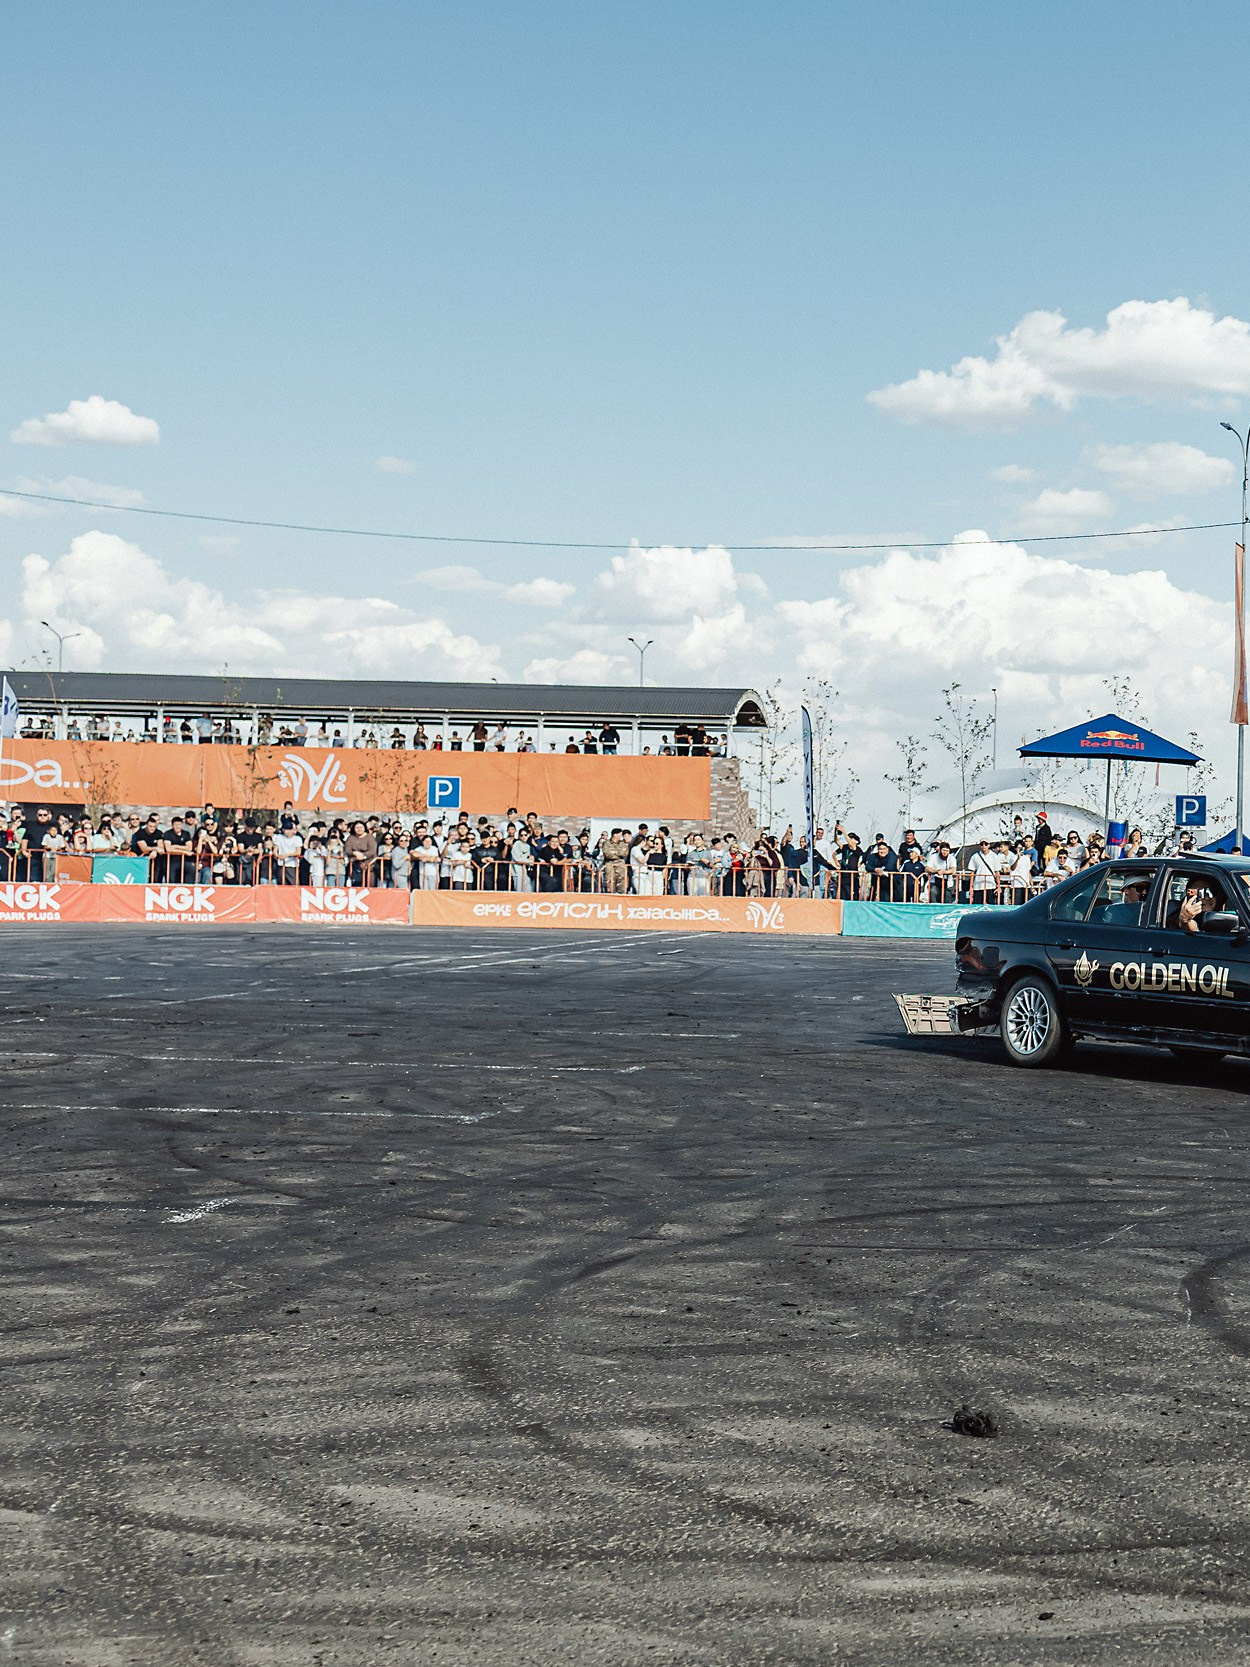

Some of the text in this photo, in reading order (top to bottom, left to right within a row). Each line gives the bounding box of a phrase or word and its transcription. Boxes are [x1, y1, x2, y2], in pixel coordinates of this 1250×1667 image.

[1080, 739, 1145, 750] Red Bull
[435, 779, 453, 805] P
[1182, 798, 1200, 823] P
[145, 887, 215, 911] NGK
[301, 888, 370, 912] NGK
[27, 912, 61, 921] PLUGS
[145, 913, 215, 922] SPARK PLUGS
[301, 913, 369, 922] SPARK PLUGS
